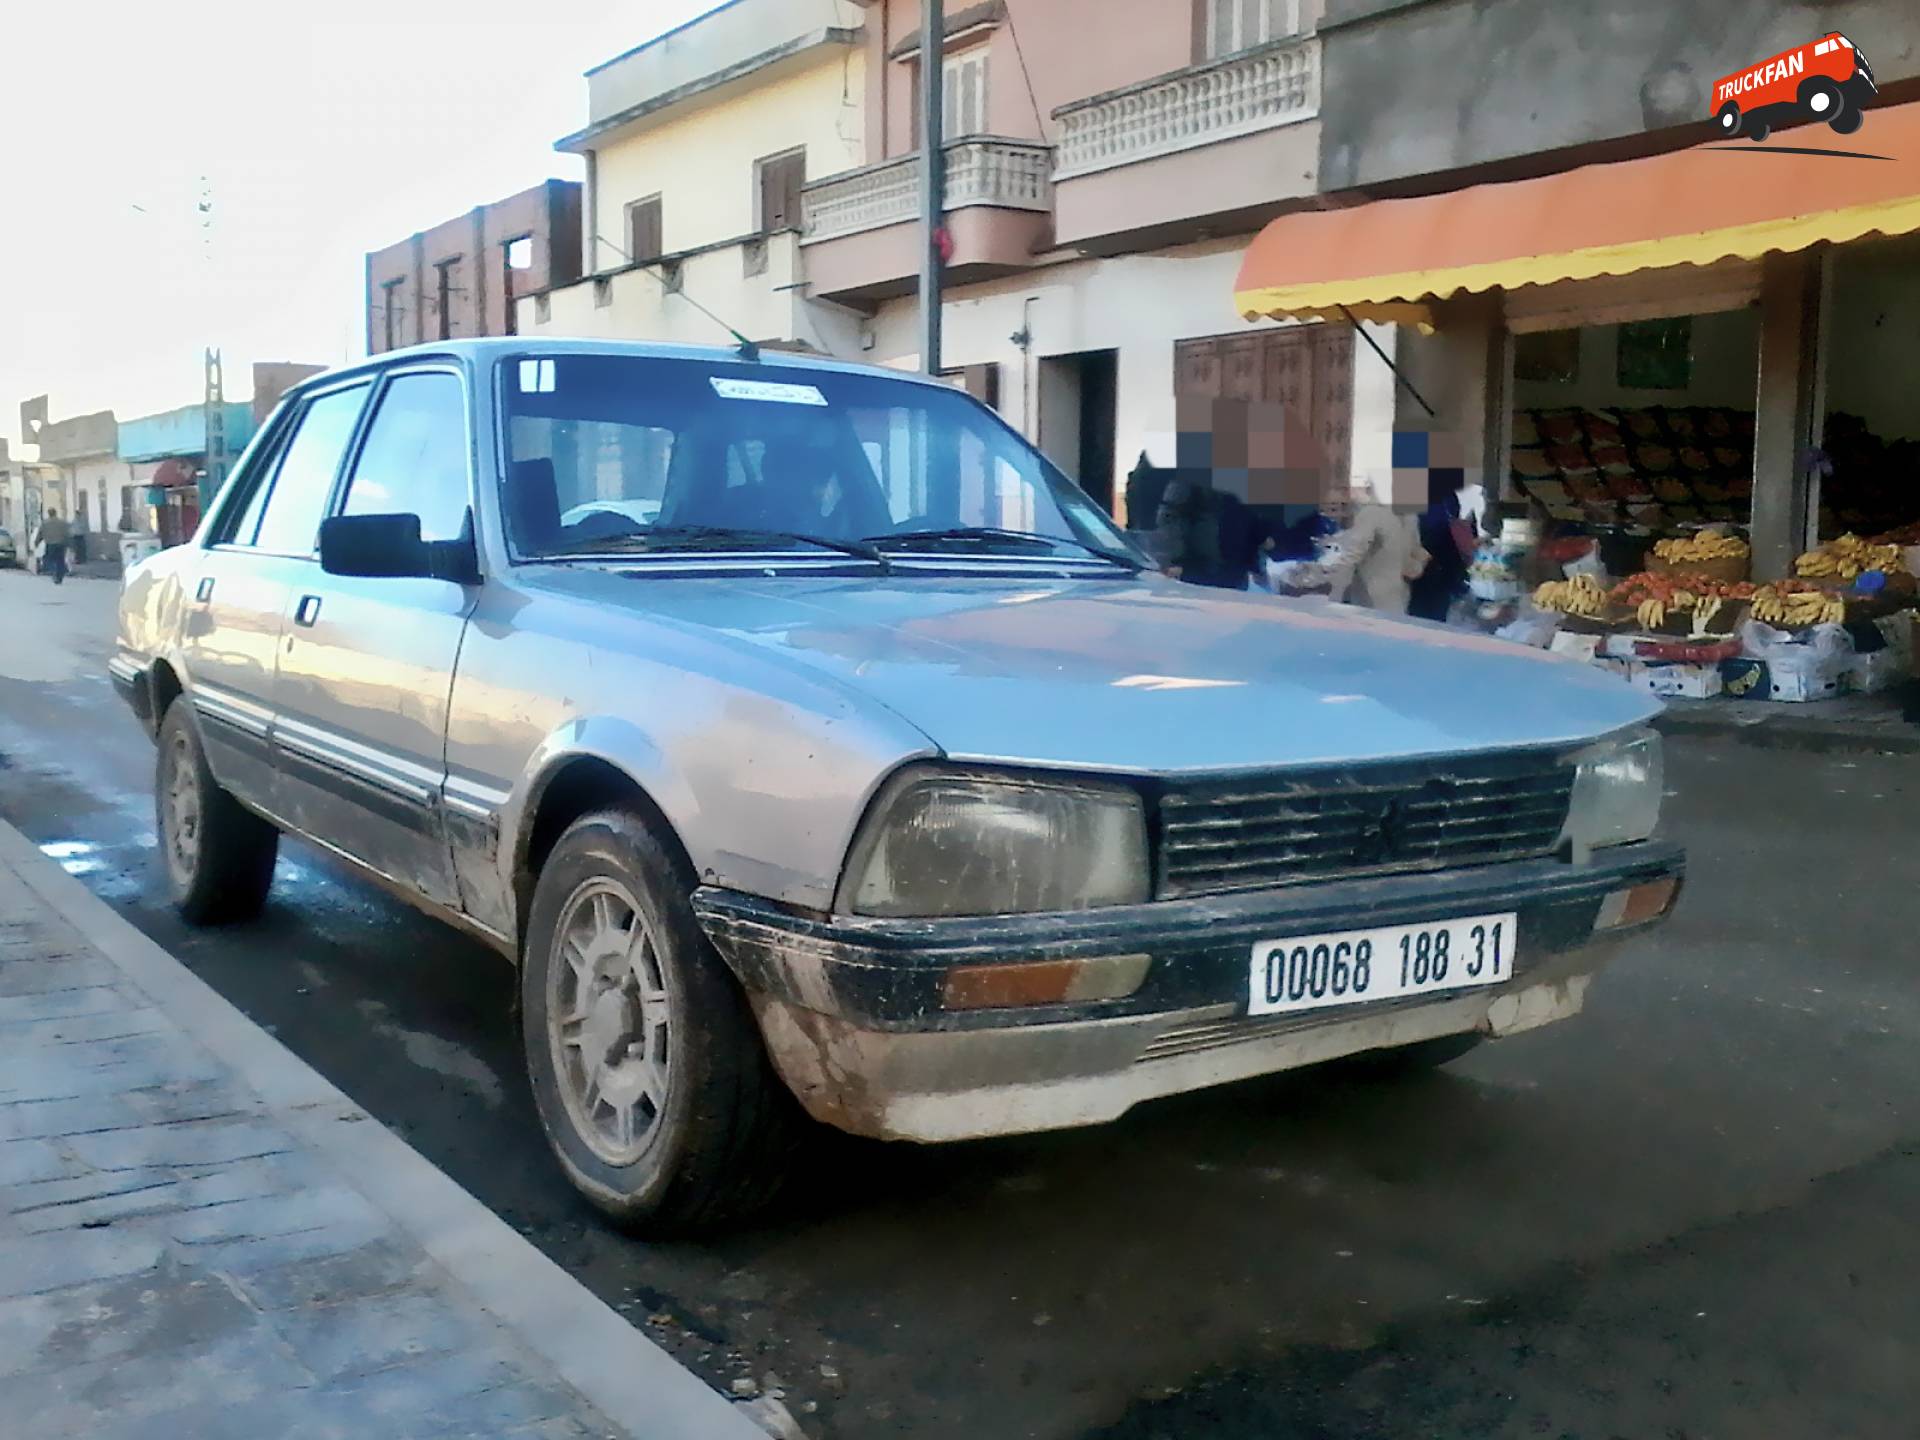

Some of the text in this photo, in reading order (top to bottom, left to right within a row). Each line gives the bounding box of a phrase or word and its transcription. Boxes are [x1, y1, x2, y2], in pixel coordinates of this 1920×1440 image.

[1266, 922, 1502, 1004] 00068 188 31
